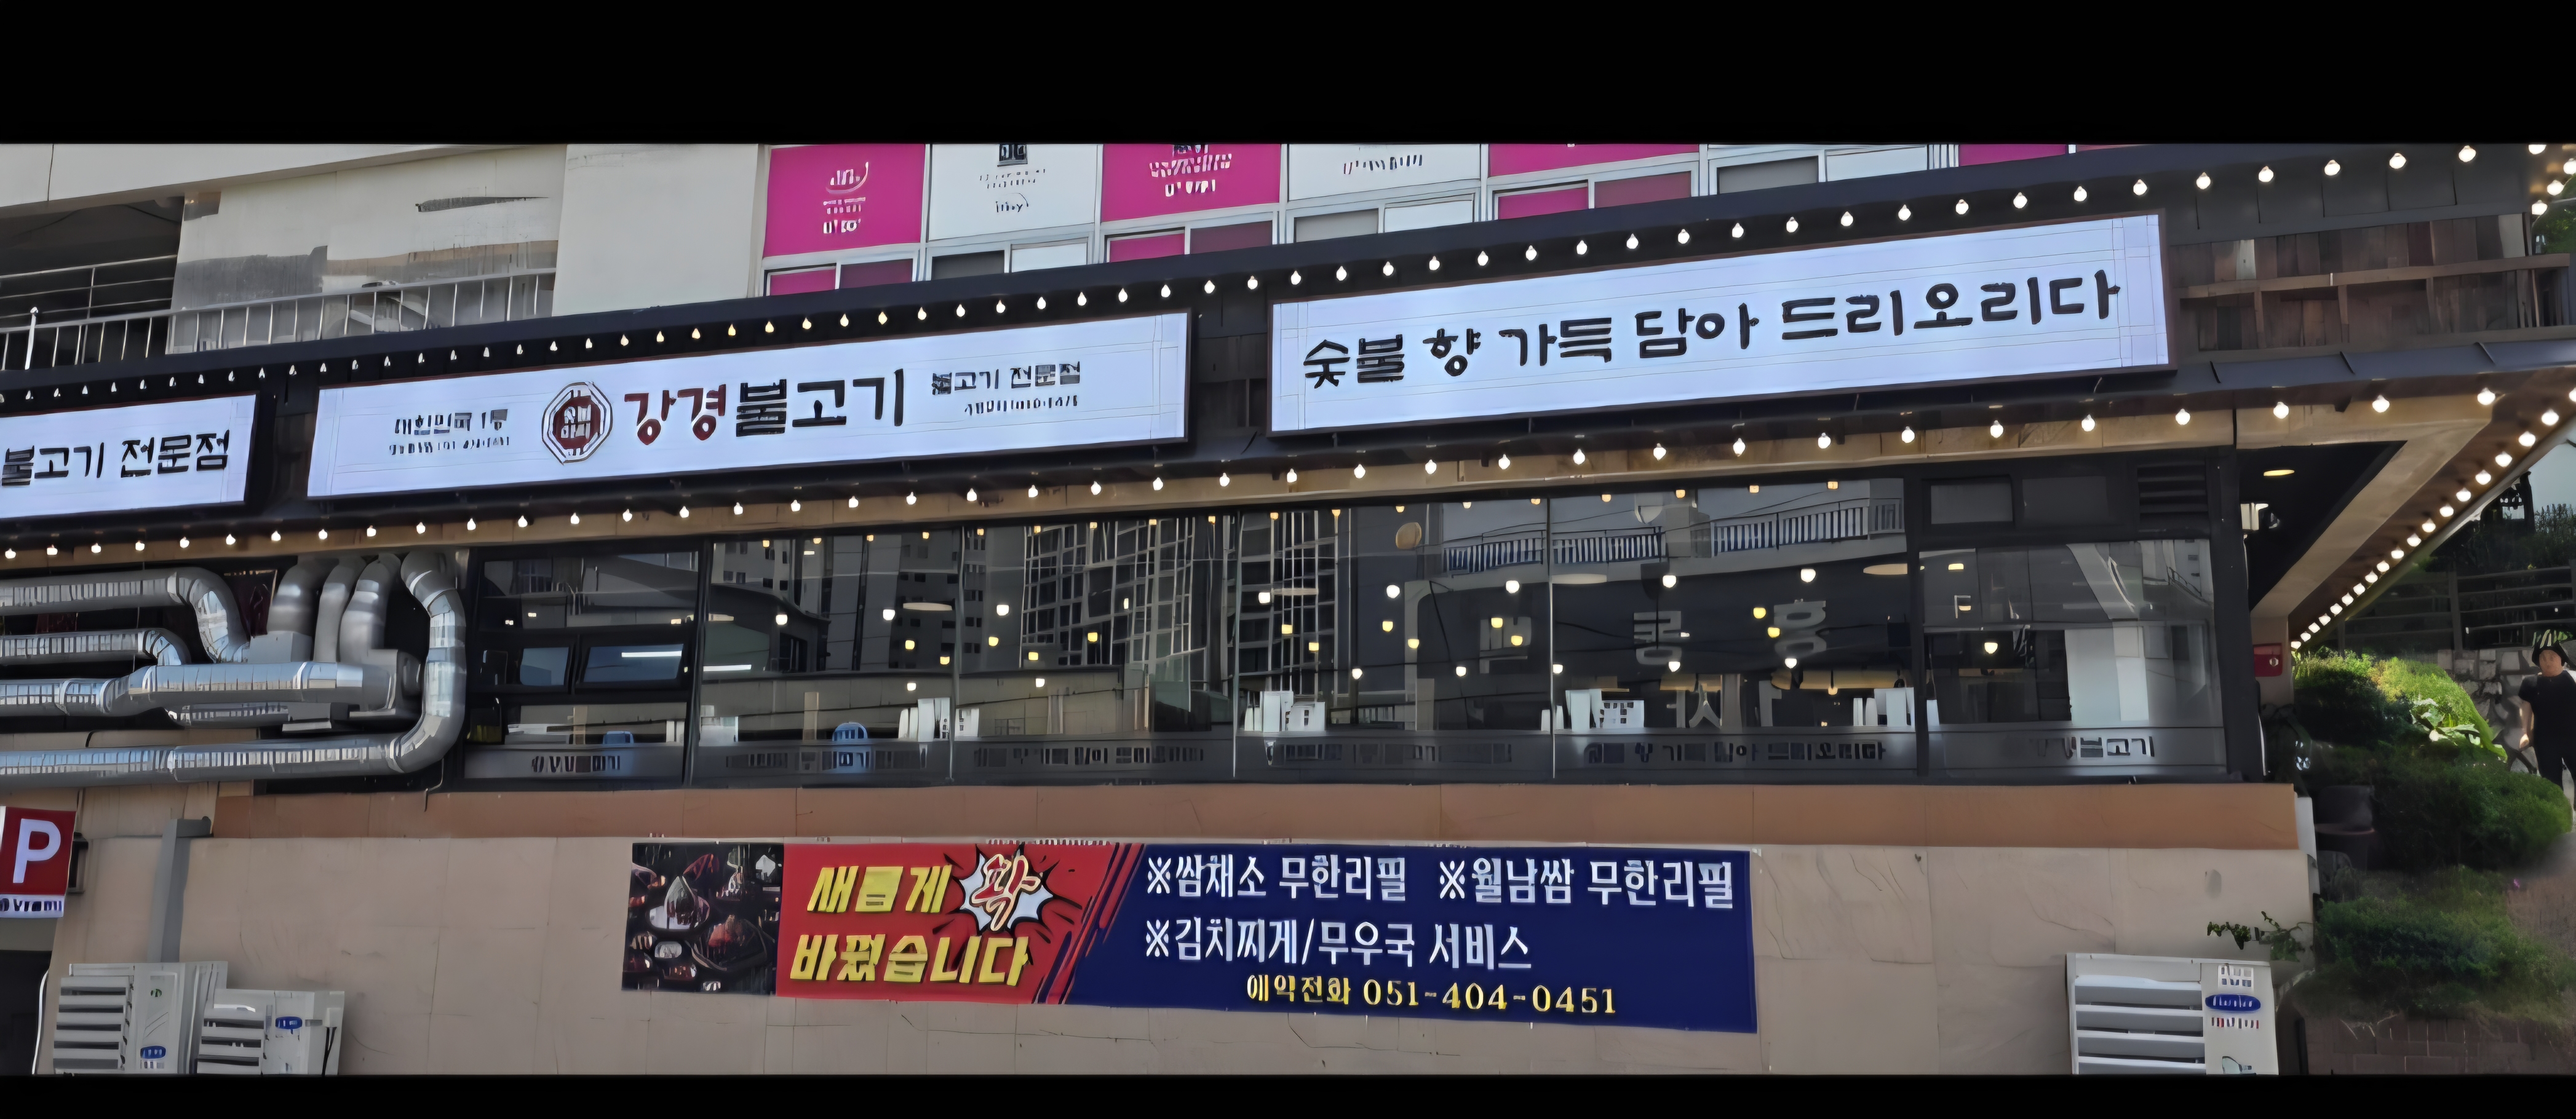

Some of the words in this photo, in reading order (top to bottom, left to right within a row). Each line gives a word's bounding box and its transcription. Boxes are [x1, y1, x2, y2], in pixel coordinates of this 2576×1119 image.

[1303, 333, 1405, 389] 숯불
[1421, 327, 1481, 377] 향
[1498, 317, 1612, 367] 가득
[1635, 302, 1760, 359] 담아
[1781, 269, 2121, 341] 드리오리다
[624, 368, 904, 446] 강경불고기
[1, 441, 105, 486] 불고기
[121, 429, 230, 478] 전문점
[12, 818, 62, 884] P
[806, 864, 953, 914] 새롭게
[1279, 853, 1406, 902] 무한리필
[1587, 858, 1733, 909] 무한리필
[1429, 923, 1532, 970] 서비스
[1363, 979, 1616, 1014] 051-404-0451
